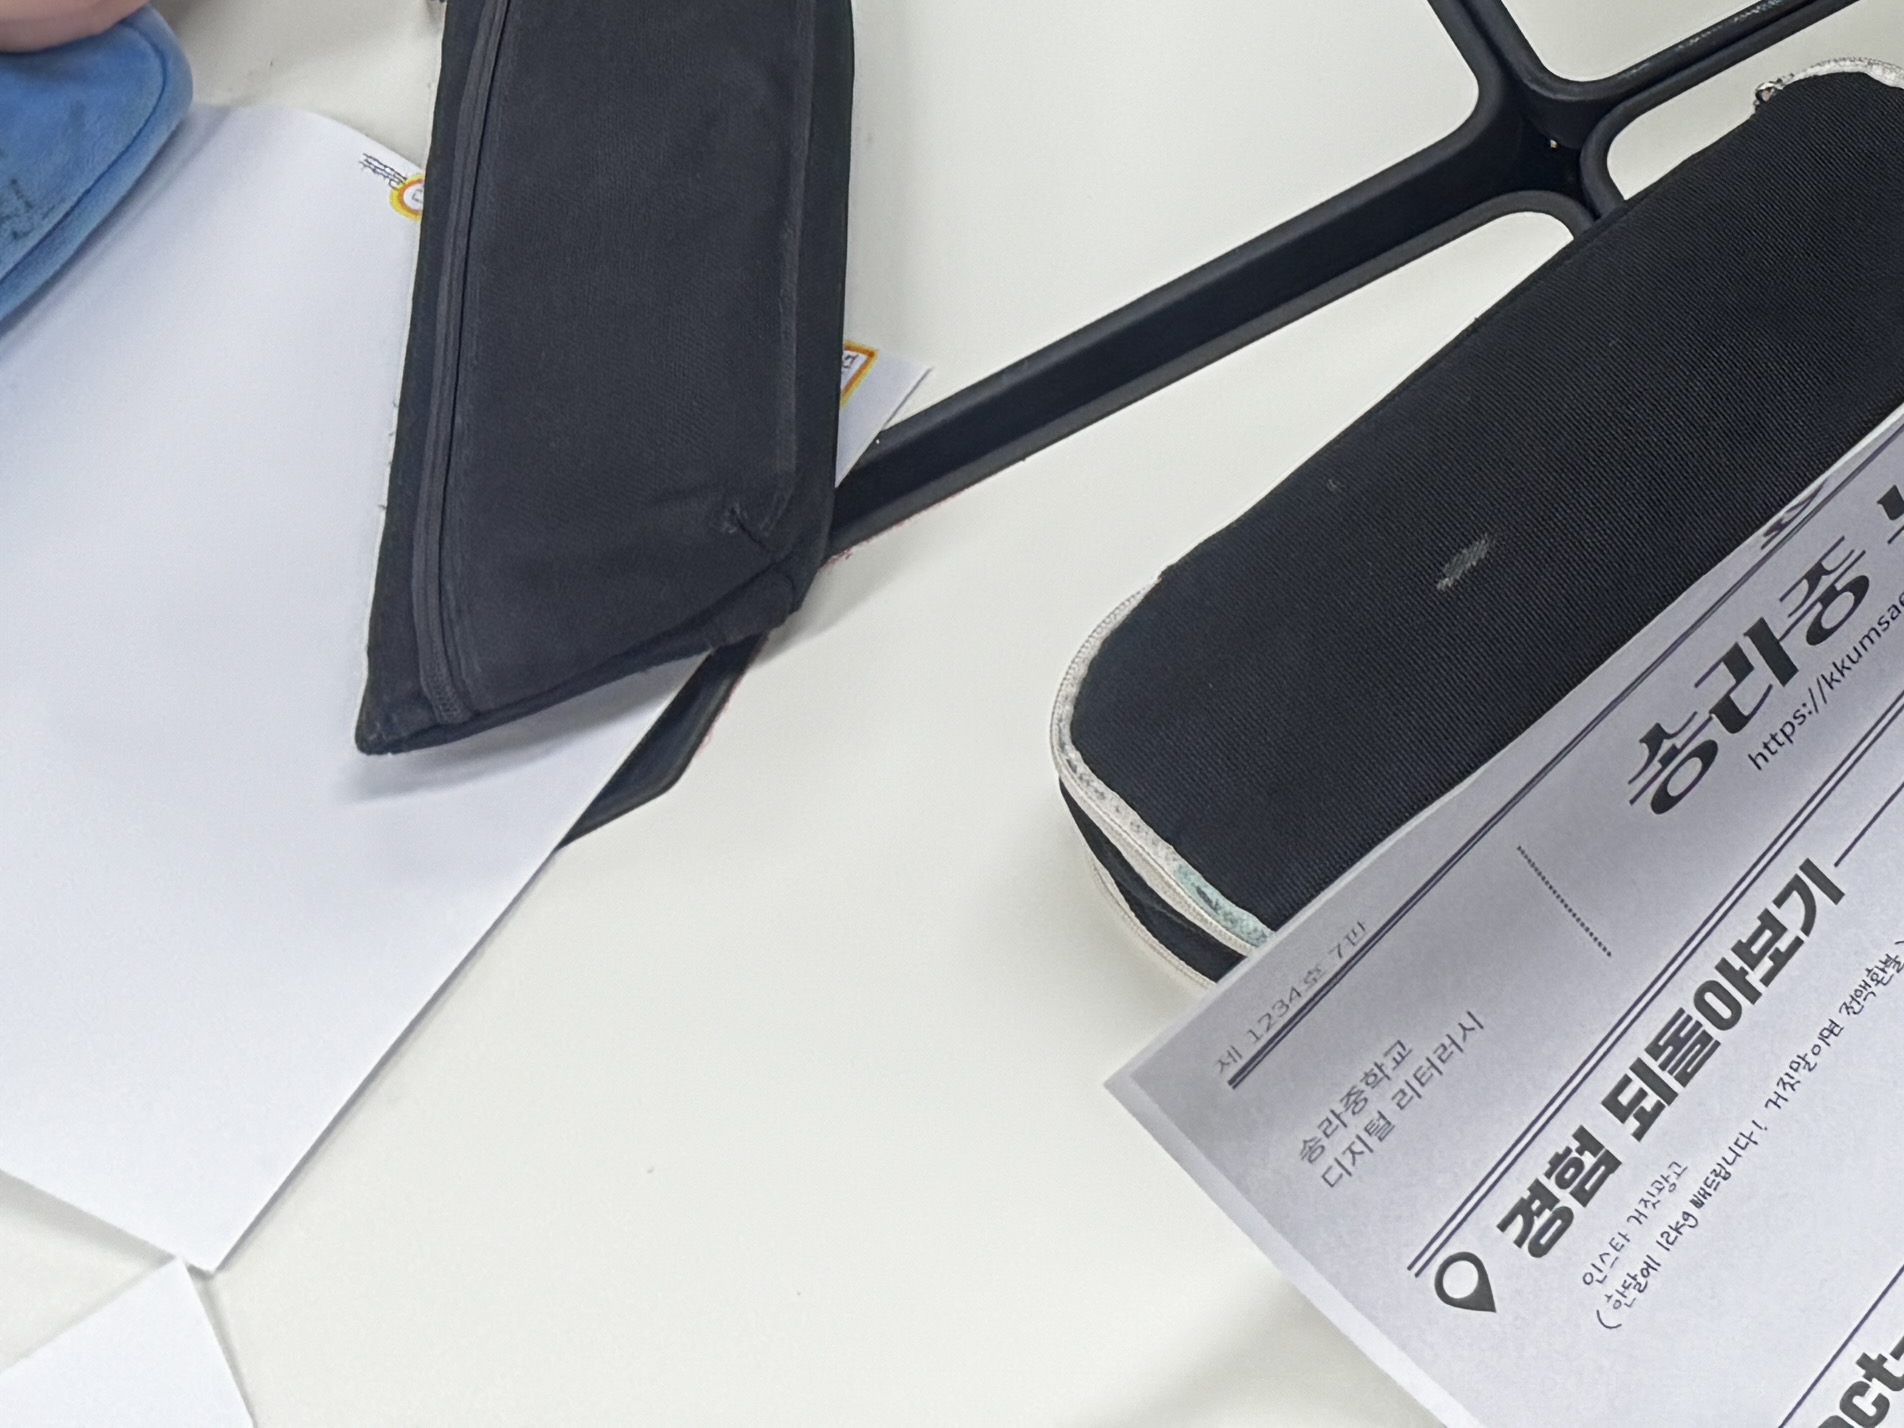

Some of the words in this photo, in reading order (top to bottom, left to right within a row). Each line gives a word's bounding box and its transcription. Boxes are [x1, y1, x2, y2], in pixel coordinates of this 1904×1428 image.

[1627, 535, 1871, 815] 송라중
[1300, 1039, 1413, 1164] 송라중학교
[1320, 1110, 1396, 1188] 디지털
[1391, 1010, 1485, 1111] 리터러시
[1495, 1124, 1623, 1259] 경험
[1600, 857, 1846, 1142] 되돌아보기
[1582, 1231, 1631, 1286] 인스타
